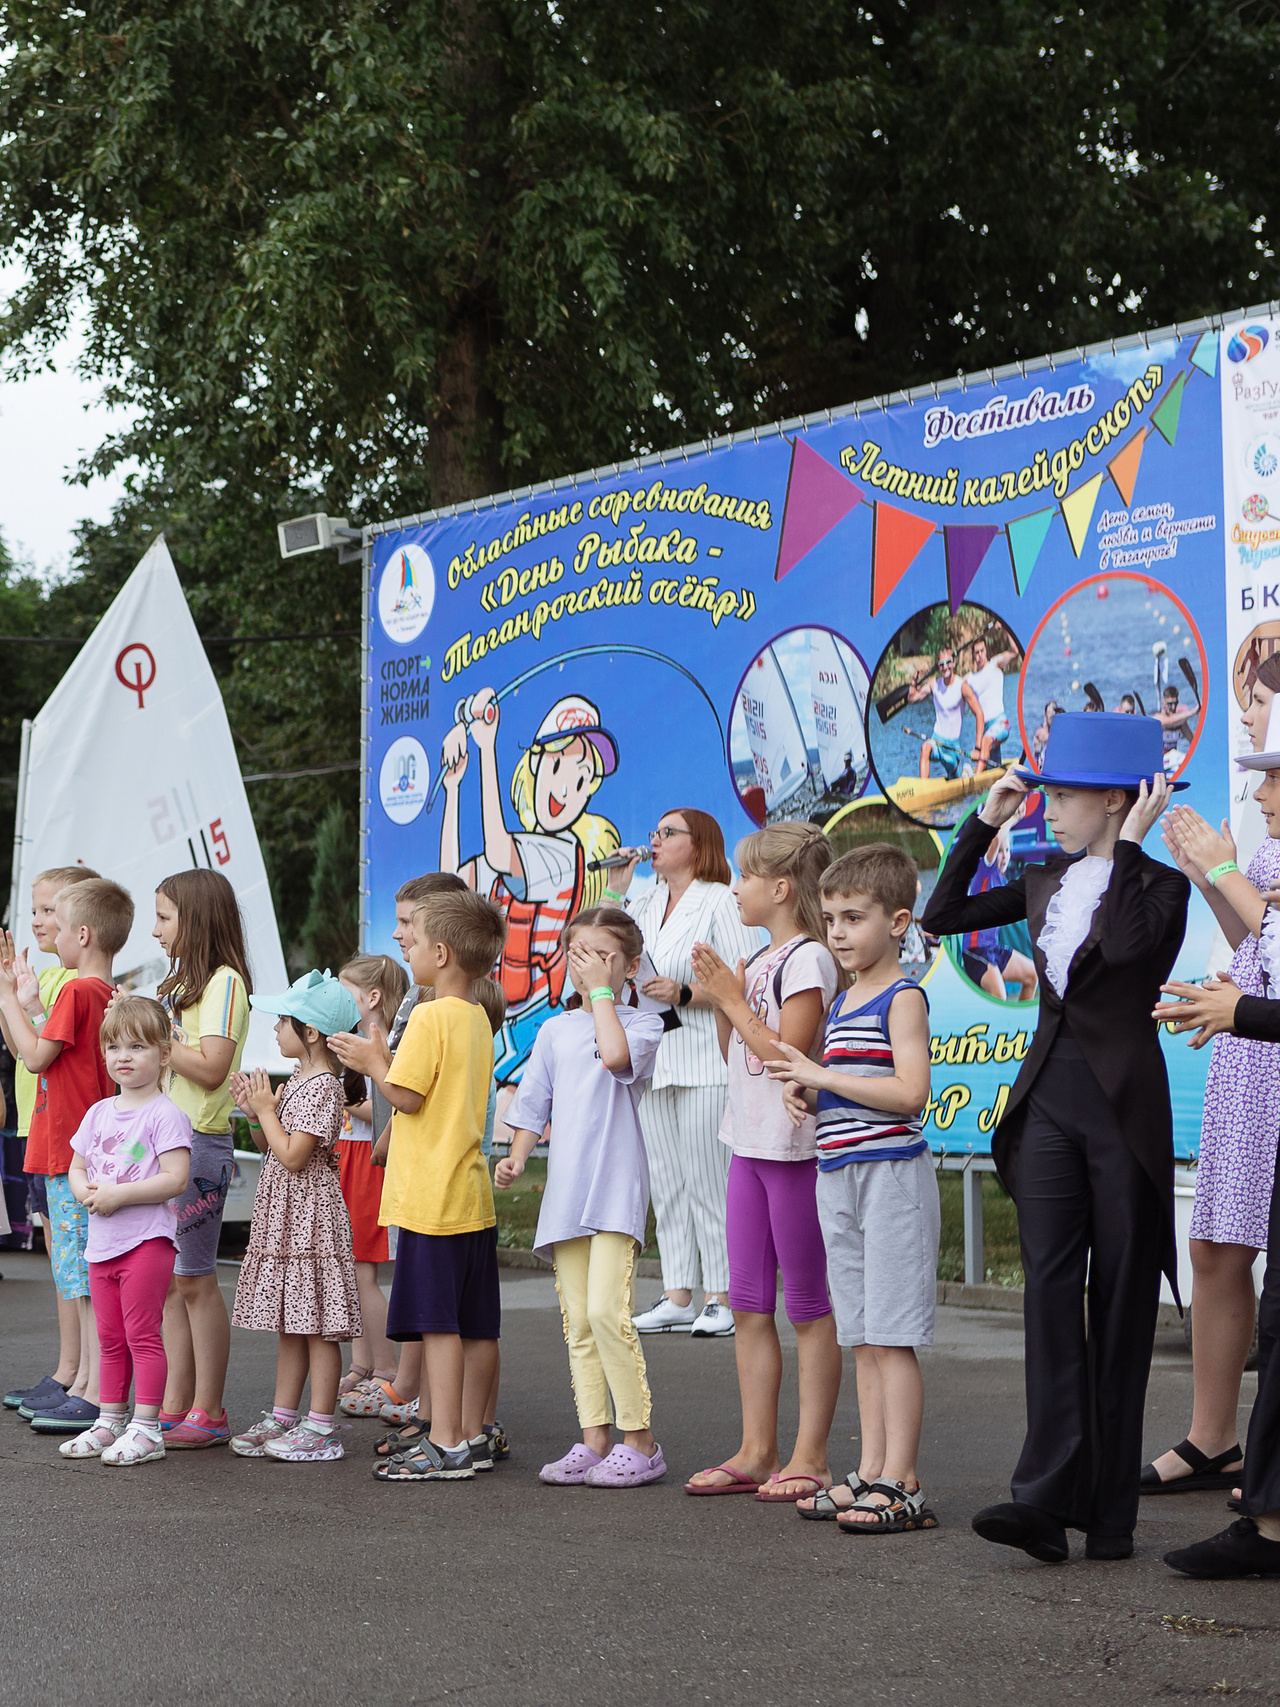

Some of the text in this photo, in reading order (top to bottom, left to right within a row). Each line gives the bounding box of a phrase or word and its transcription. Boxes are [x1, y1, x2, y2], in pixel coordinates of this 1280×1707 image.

[924, 384, 1094, 447] Фестиваль
[839, 441, 959, 506] «Летний
[962, 365, 1164, 507] калейдоскоп»
[1098, 502, 1174, 532] День семьи,
[1099, 516, 1215, 549] любви и верности
[447, 481, 773, 591] Областные соревнования
[480, 558, 564, 613] «День
[573, 521, 698, 575] Рыбака
[1100, 538, 1177, 569] в Таганроге!
[441, 567, 757, 683] Таганрогский осётр»
[381, 655, 421, 680] СПОРТ
[381, 676, 429, 703] НОРМА
[381, 698, 429, 726] ЖИЗНИ
[169, 1193, 219, 1222] Emma
[207, 1210, 214, 1219] 7
